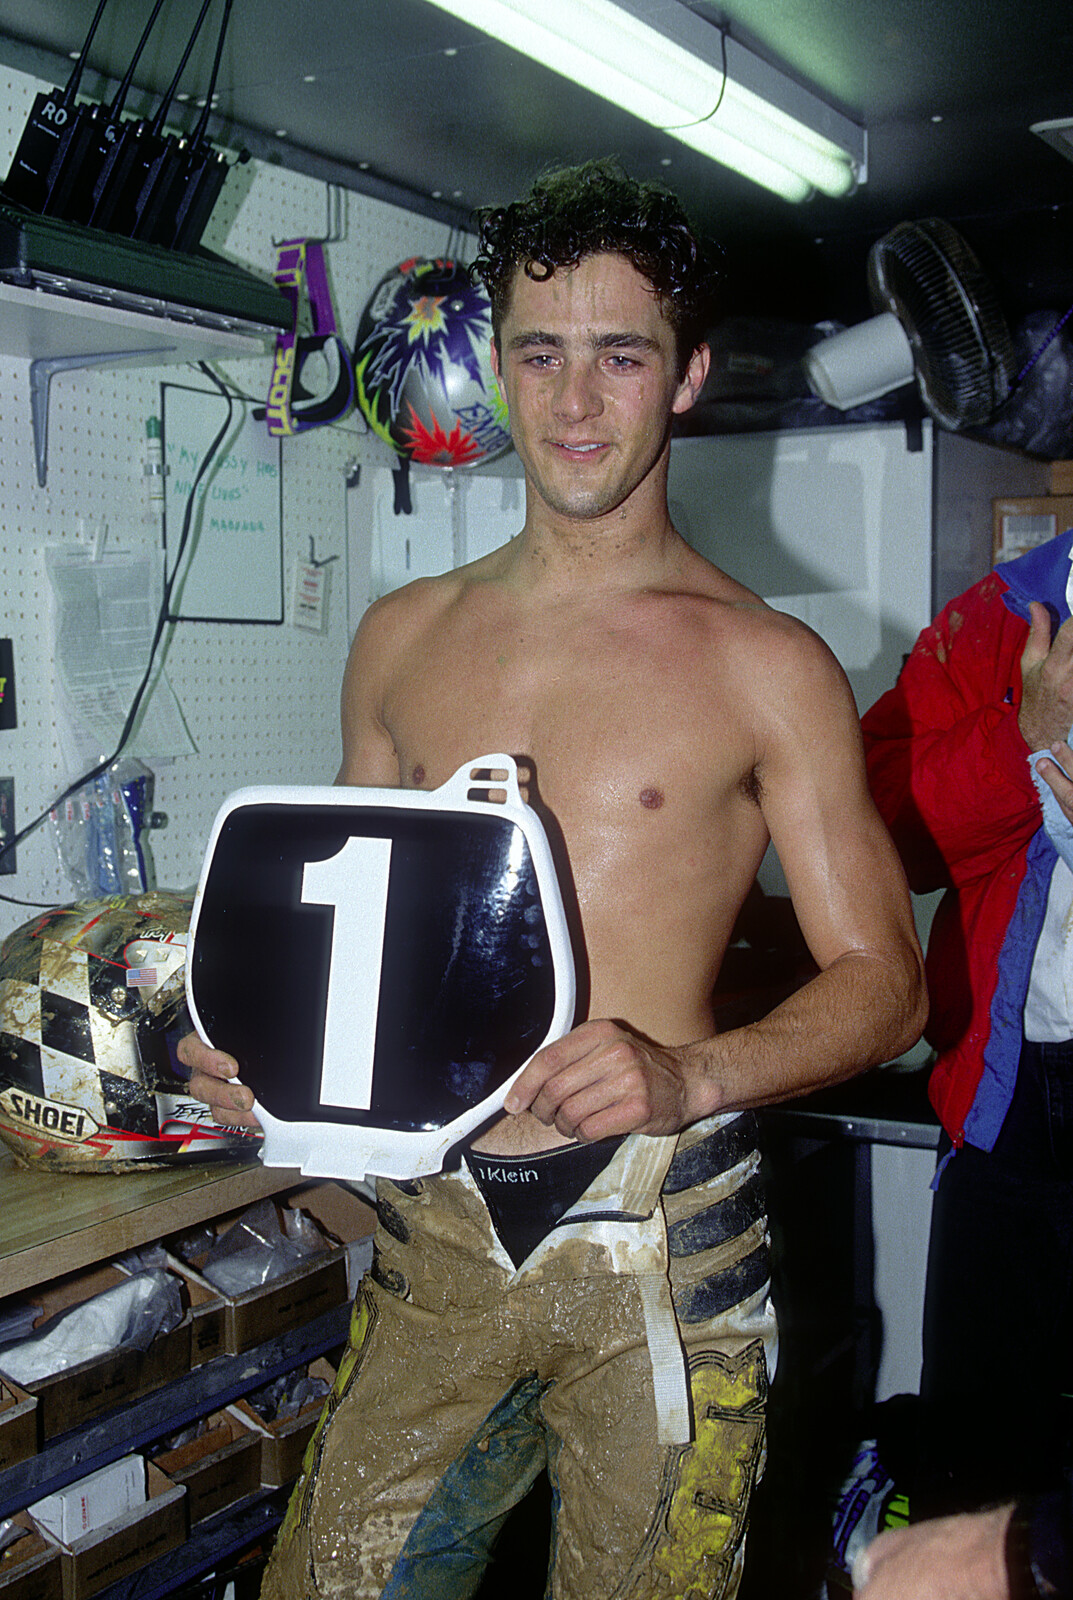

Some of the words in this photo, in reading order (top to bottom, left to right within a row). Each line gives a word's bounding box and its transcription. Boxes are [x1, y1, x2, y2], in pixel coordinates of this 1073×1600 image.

[300, 835, 393, 1110] 1
[9, 1093, 86, 1137] SHOEI
[487, 1166, 539, 1183] Klein
